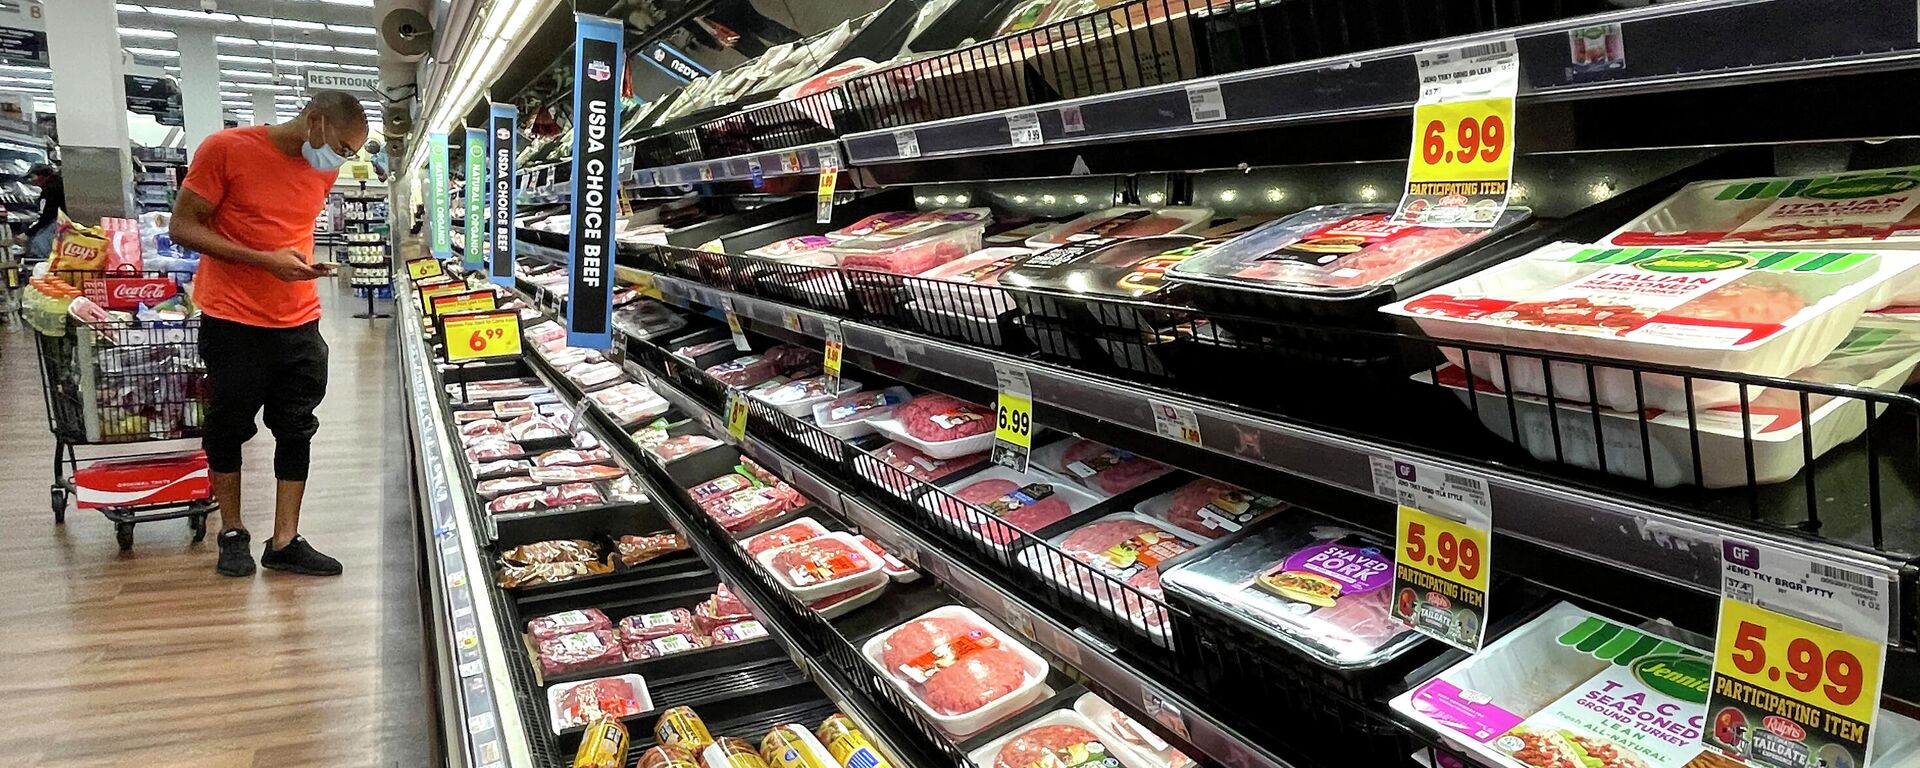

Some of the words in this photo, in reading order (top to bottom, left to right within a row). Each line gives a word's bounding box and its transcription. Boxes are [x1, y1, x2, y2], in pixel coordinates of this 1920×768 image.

[310, 75, 380, 88] RESTROOMS
[1477, 67, 1492, 75] LEAN
[588, 100, 606, 154] USDA
[1422, 115, 1505, 165] 6.99
[435, 162, 444, 197] NATURAL
[497, 149, 509, 179] USDA
[471, 164, 480, 203] NATURAL
[585, 159, 605, 239] CHOICE
[1410, 183, 1478, 195] PARTICIPATING
[1480, 182, 1506, 195] ITEM
[497, 181, 509, 225] CHOICE
[470, 214, 479, 255] ORGANIC
[497, 227, 508, 252] BEEF
[583, 244, 601, 287] BEEF
[1596, 273, 1718, 284] ITALIAN
[1584, 280, 1700, 290] SEASONED
[999, 405, 1030, 436] 6.99
[1307, 553, 1379, 581] PORK
[1324, 546, 1388, 571] SHAVED
[1406, 522, 1480, 580] 5.99
[1732, 546, 1750, 561] GF
[1398, 565, 1458, 598] PARTICIPATING
[1460, 583, 1483, 608] ITEM
[1726, 564, 1750, 577] JENO
[1753, 572, 1772, 584] TKY
[1775, 577, 1803, 592] BRGR
[1806, 584, 1834, 599] PTTY
[1868, 601, 1880, 611] OZ
[1731, 620, 1864, 706] 5.99
[1576, 698, 1632, 724] GROUND
[1633, 721, 1690, 748] TURKEY
[1585, 690, 1700, 740] SEASONED
[1715, 676, 1821, 729] PARTICIPATING
[1824, 713, 1865, 744] ITEM
[1601, 718, 1646, 741] LEAN
[1767, 717, 1800, 738] Ralphs
[1753, 736, 1808, 765] TAILGATE
